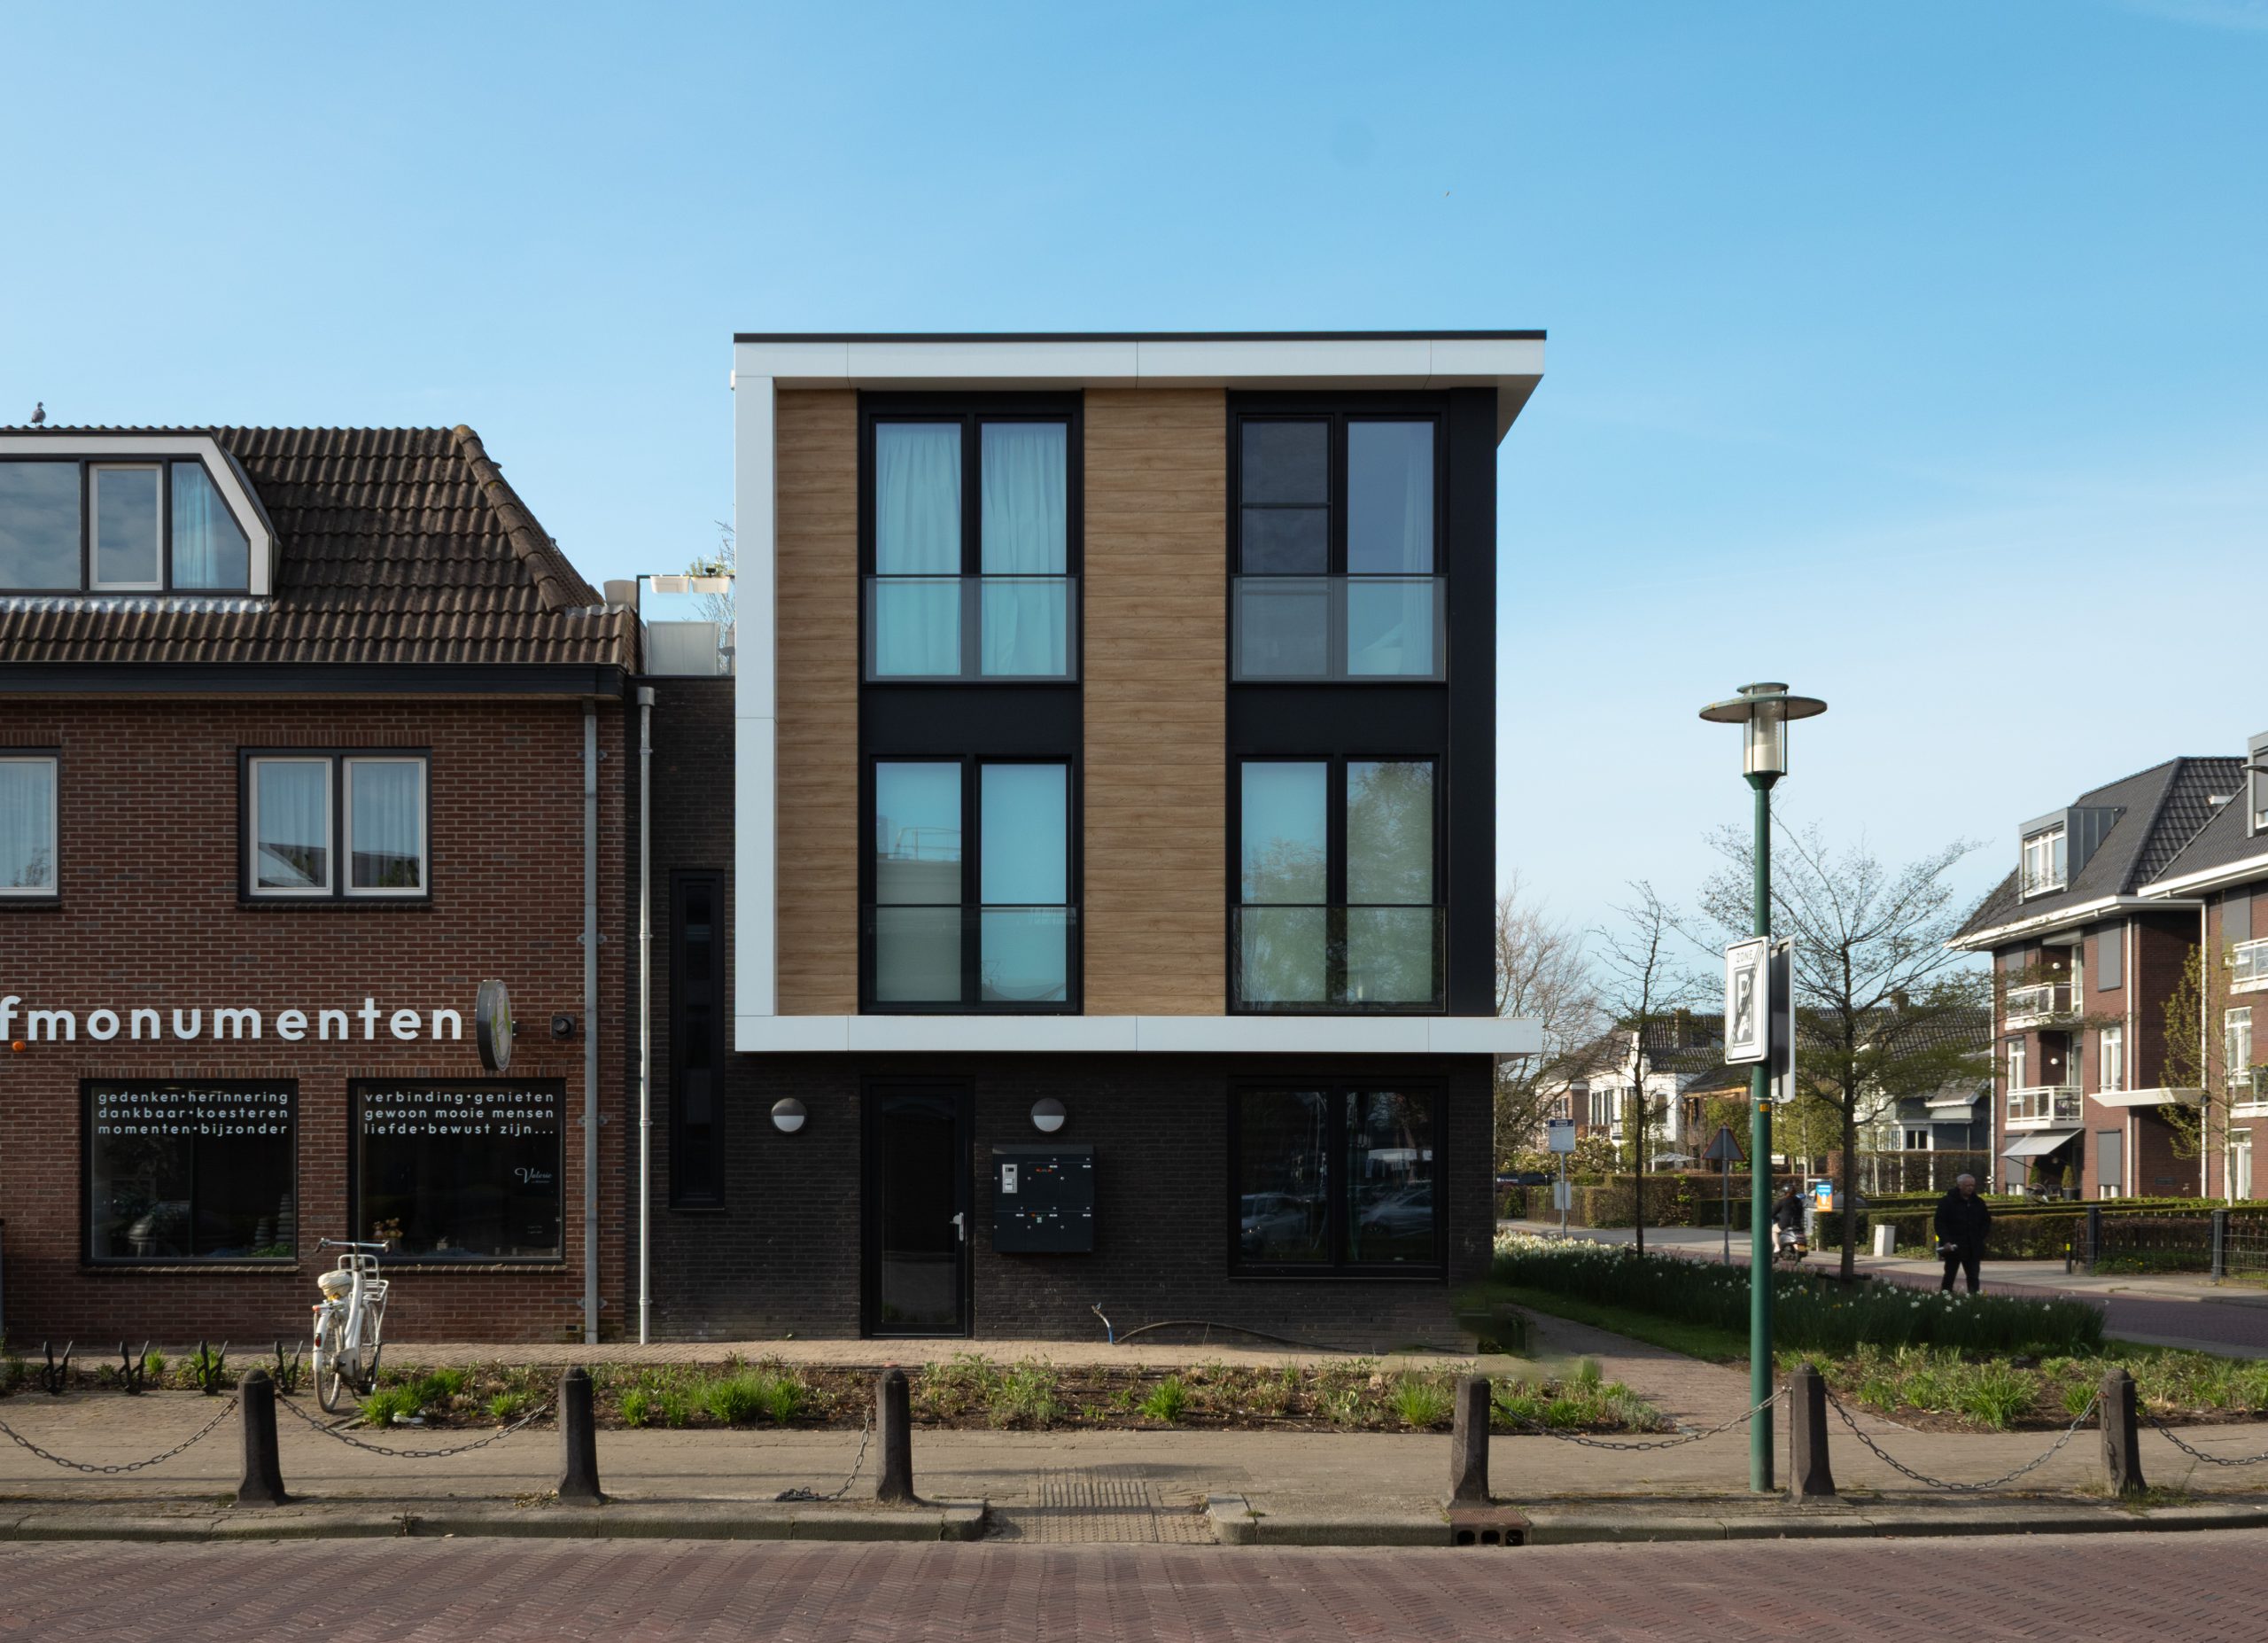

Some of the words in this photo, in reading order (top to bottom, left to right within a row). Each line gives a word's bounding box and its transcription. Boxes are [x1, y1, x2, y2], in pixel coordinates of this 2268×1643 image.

[1736, 949, 1753, 963] ZONE
[0, 995, 462, 1041] fmonumenten
[365, 1110, 427, 1121] gewoon
[435, 1107, 485, 1118] mooie
[493, 1110, 554, 1118] mensen
[501, 1123, 554, 1137] zijn...
